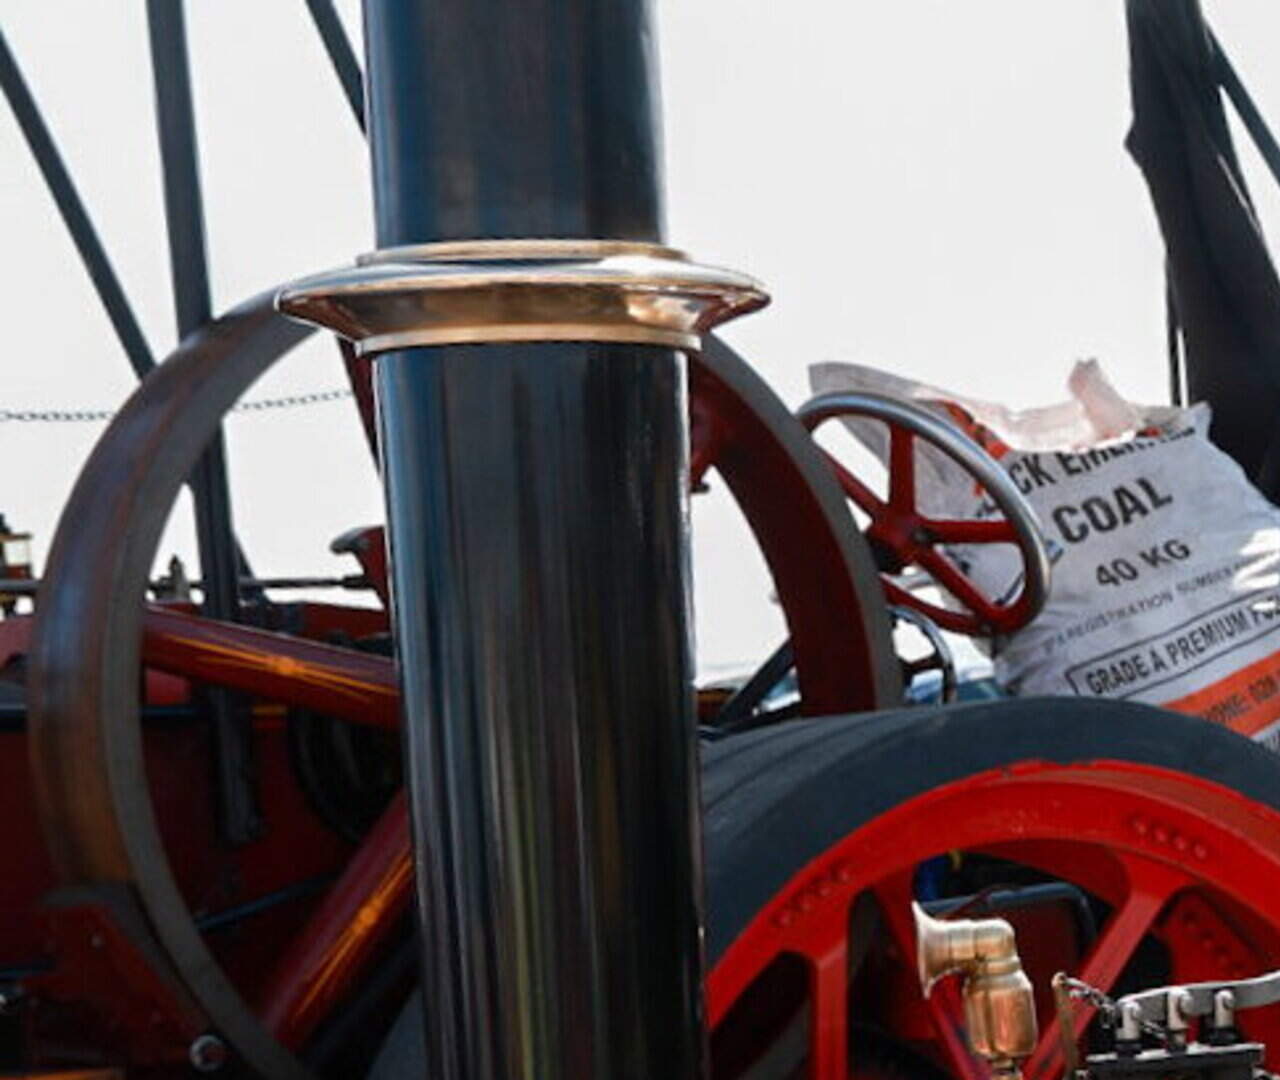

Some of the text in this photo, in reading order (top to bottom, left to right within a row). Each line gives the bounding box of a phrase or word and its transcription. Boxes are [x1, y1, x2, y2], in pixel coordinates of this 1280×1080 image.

[1052, 476, 1173, 544] COAL
[1095, 539, 1191, 586] 40 KG
[1085, 653, 1150, 694] GRADE
[1151, 648, 1167, 672] A
[1165, 610, 1250, 665] PREMIUM
